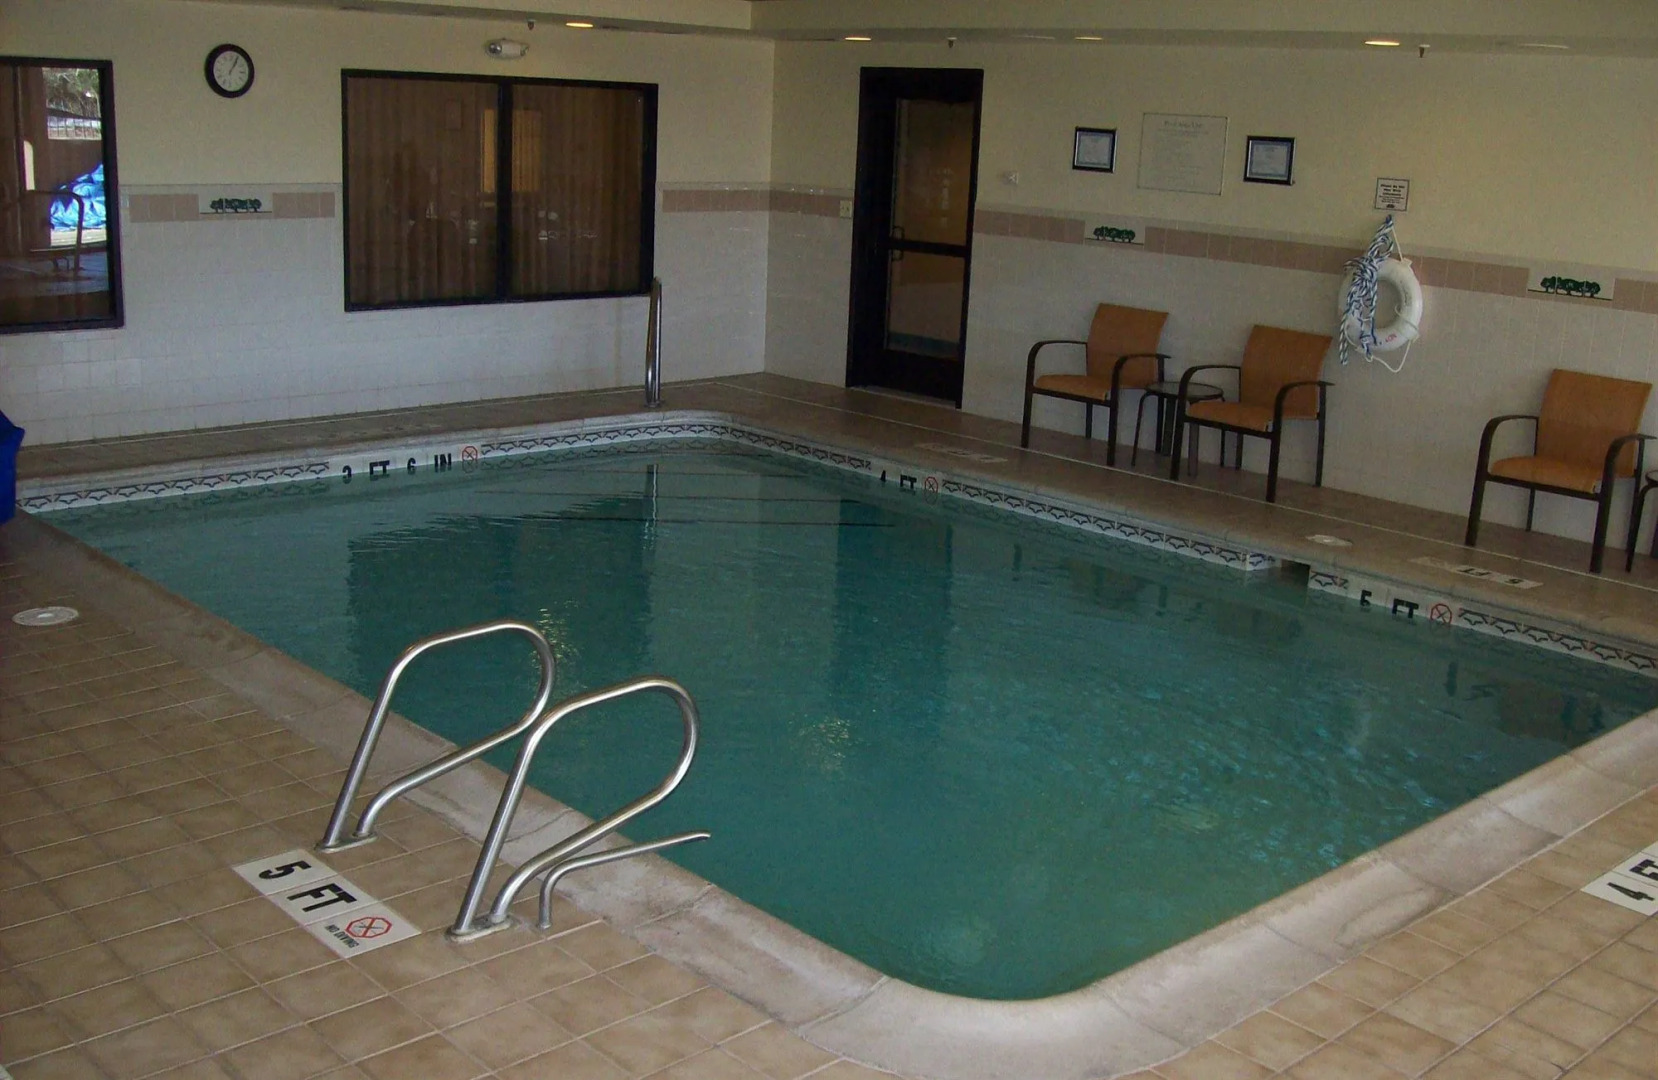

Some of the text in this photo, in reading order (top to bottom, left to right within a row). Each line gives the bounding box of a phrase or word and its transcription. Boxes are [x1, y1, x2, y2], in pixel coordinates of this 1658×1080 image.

[258, 860, 357, 912] 5 FT
[1607, 882, 1655, 901] 4
[325, 924, 359, 948] NO DIVING
